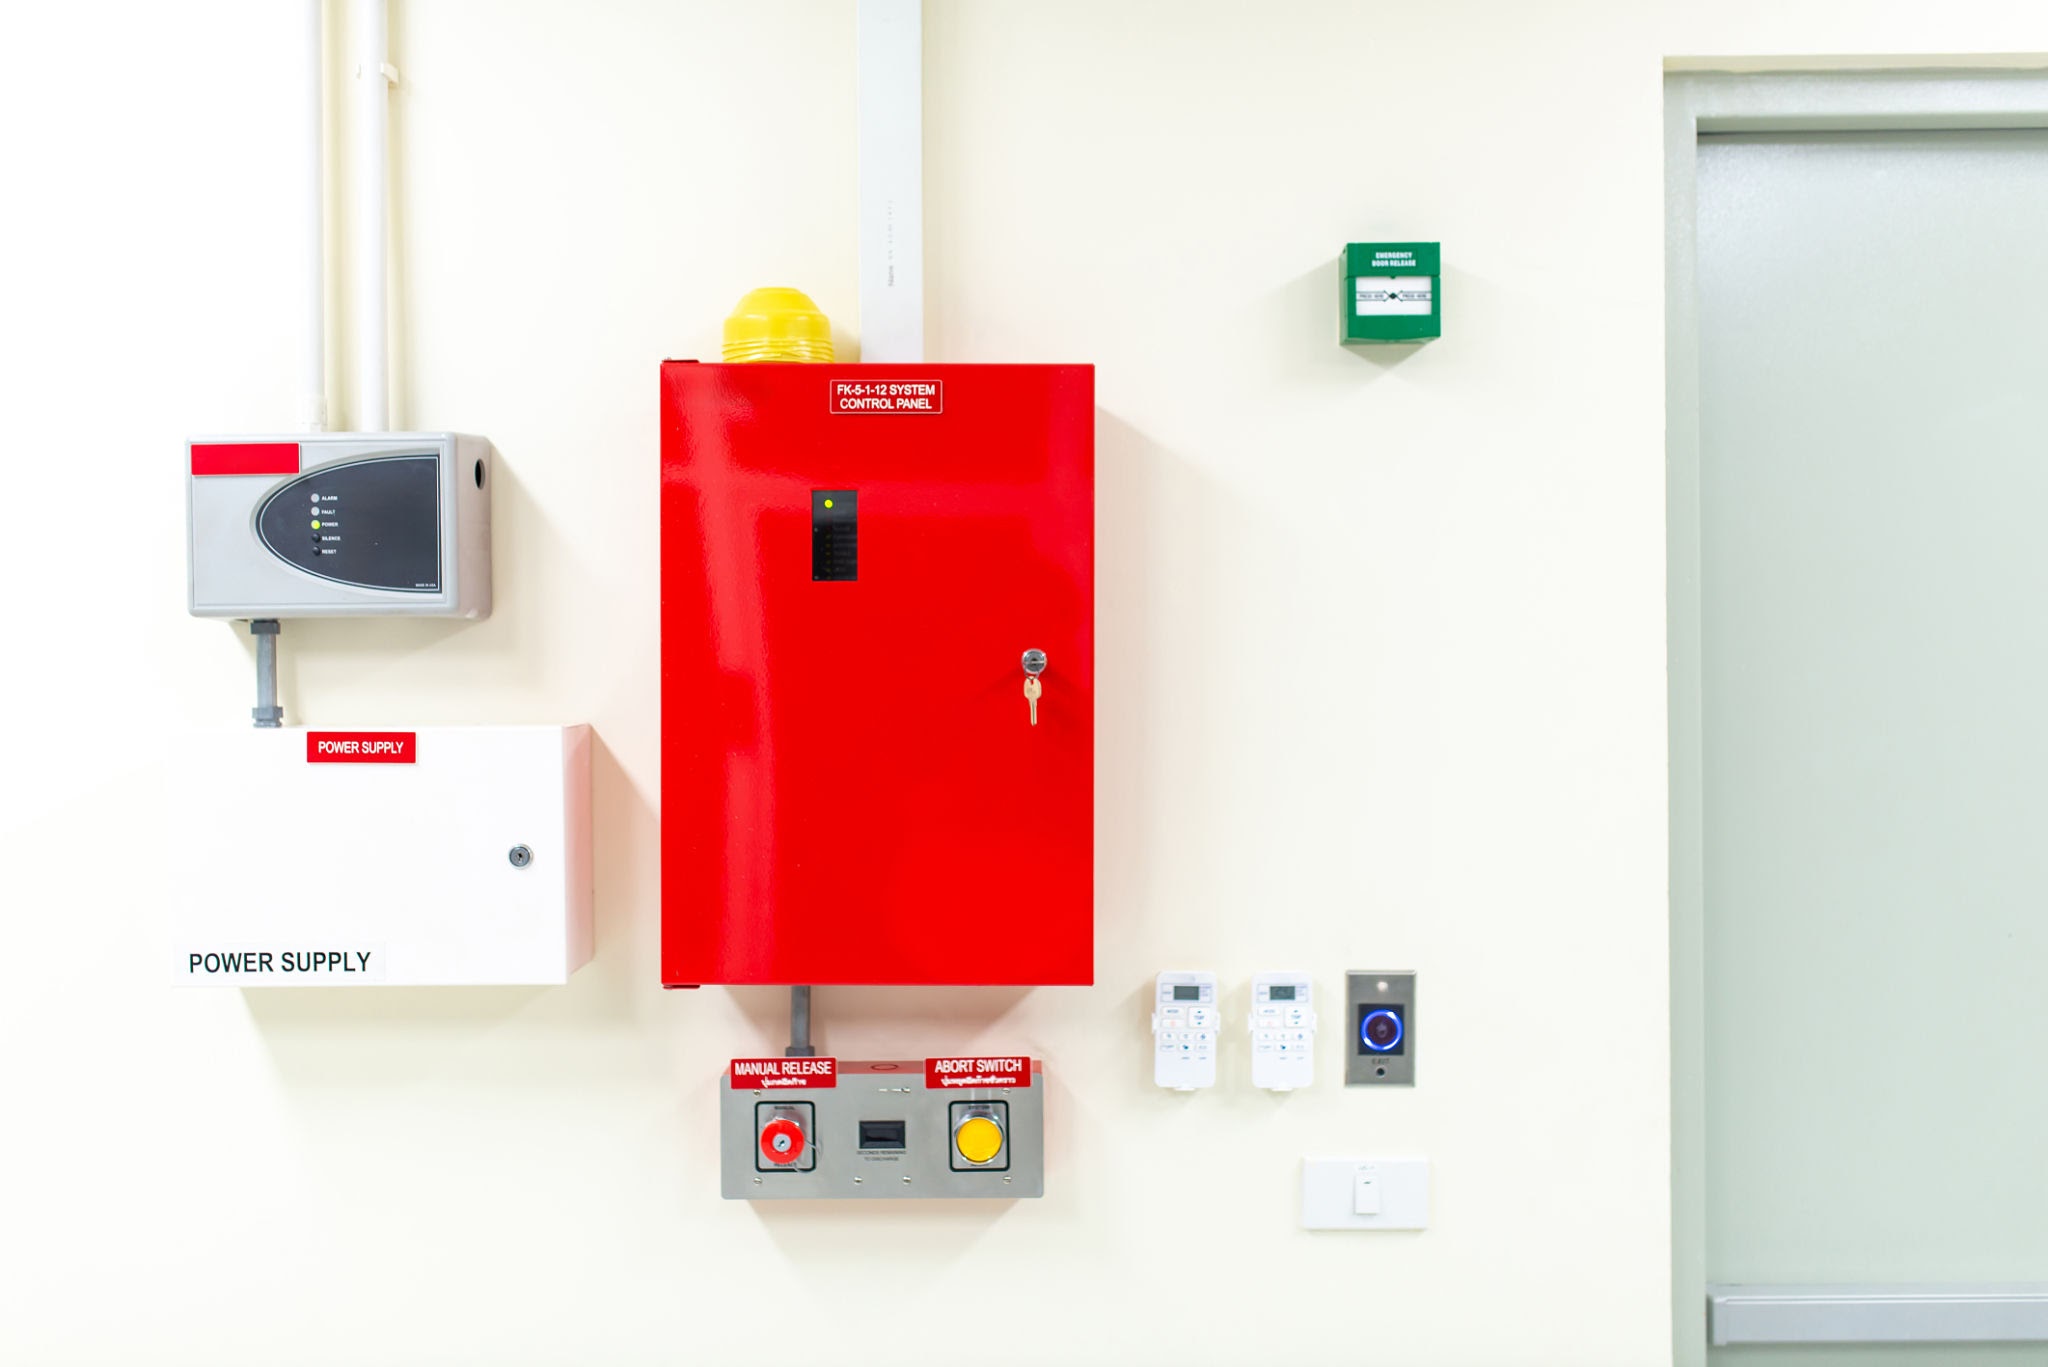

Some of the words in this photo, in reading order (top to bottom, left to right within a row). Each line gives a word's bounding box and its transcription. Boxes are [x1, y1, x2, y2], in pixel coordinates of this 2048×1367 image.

[837, 384, 887, 396] FK-5-1-12
[889, 384, 936, 396] SYSTEM
[840, 398, 894, 410] CONTROL
[896, 398, 932, 409] PANEL
[318, 740, 359, 755] POWER
[361, 740, 404, 755] SUPPLY
[189, 952, 274, 974] POWER
[281, 951, 371, 973] SUPPLY
[734, 1062, 780, 1075] MANUAL
[781, 1061, 833, 1075] RELEASE
[935, 1060, 975, 1073] ABORT
[976, 1059, 1023, 1073] SWITCH
